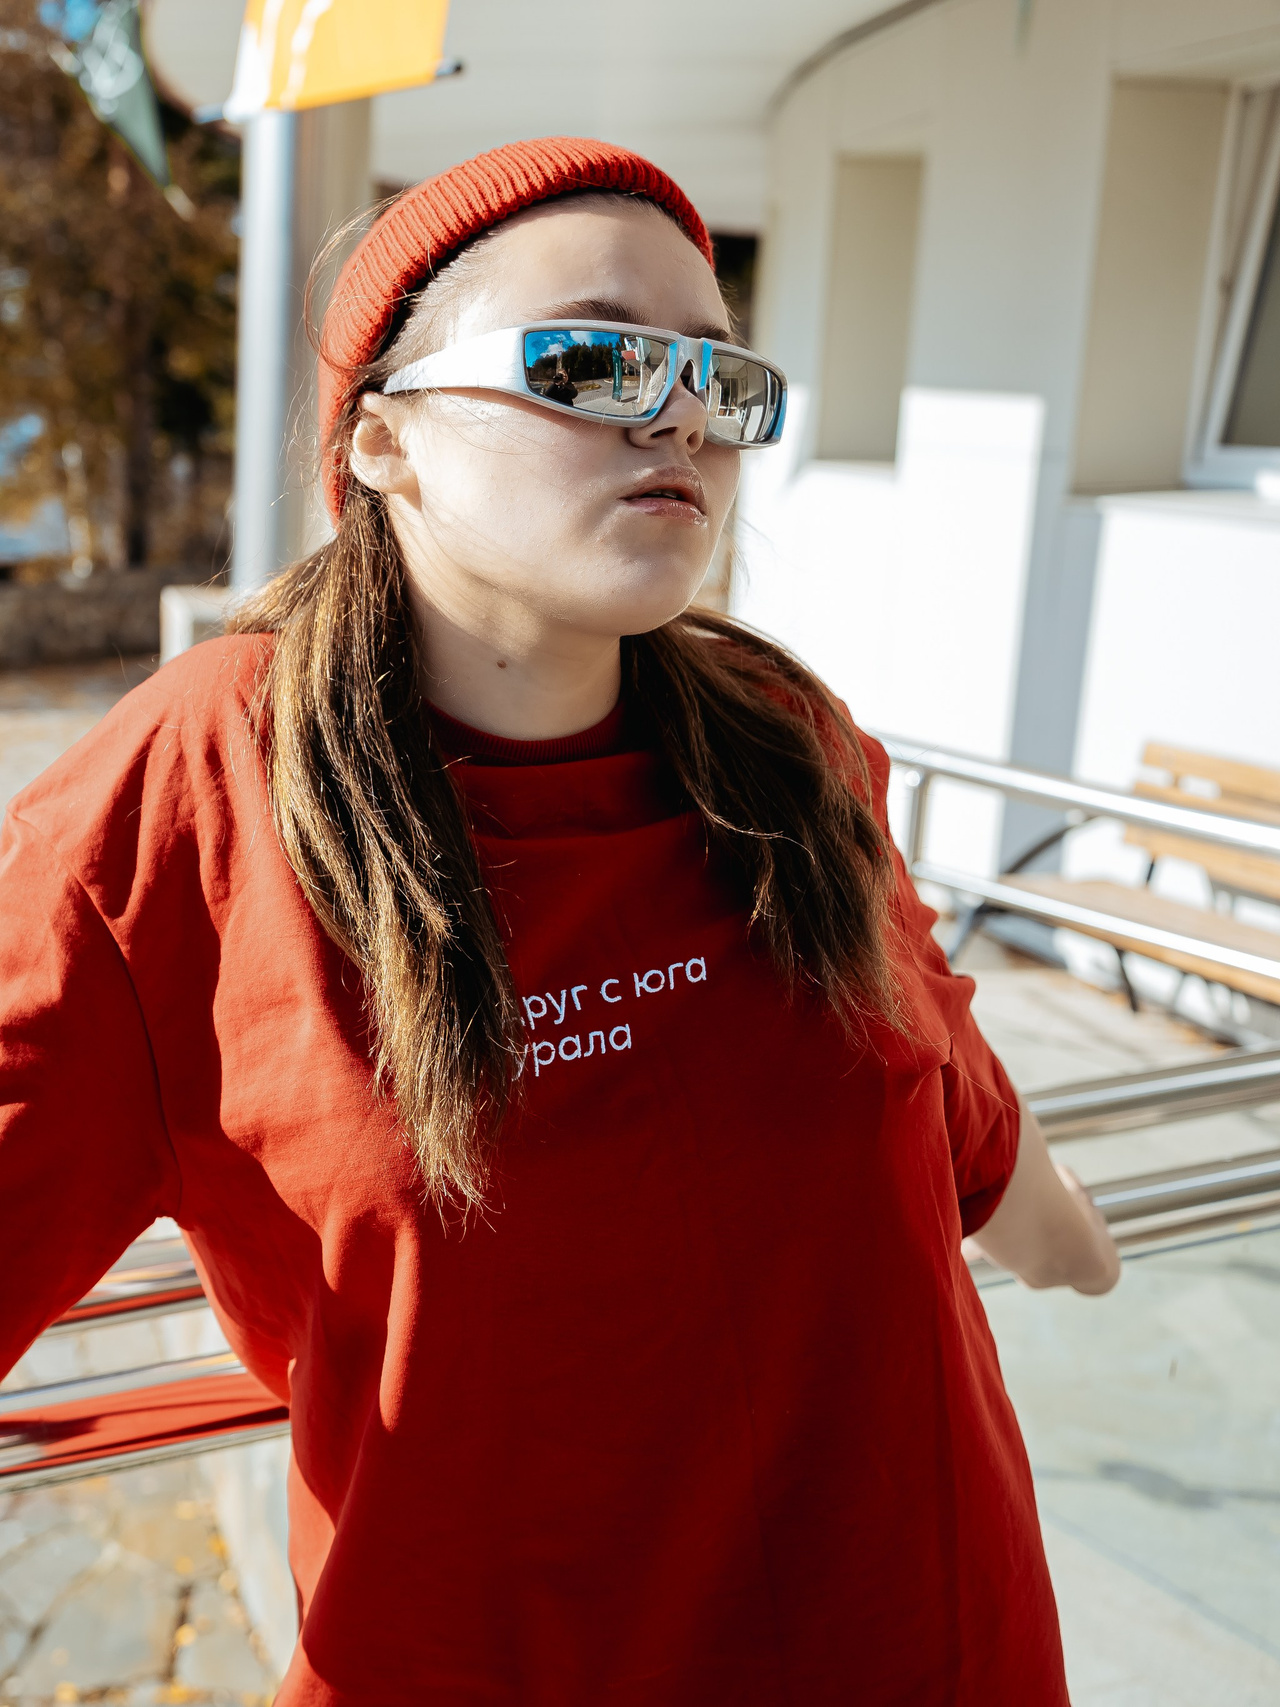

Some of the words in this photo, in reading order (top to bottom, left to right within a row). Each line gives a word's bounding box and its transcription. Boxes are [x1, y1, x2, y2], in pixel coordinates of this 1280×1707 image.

[504, 984, 588, 1031] руг
[599, 978, 623, 1004] с
[632, 956, 708, 998] юга
